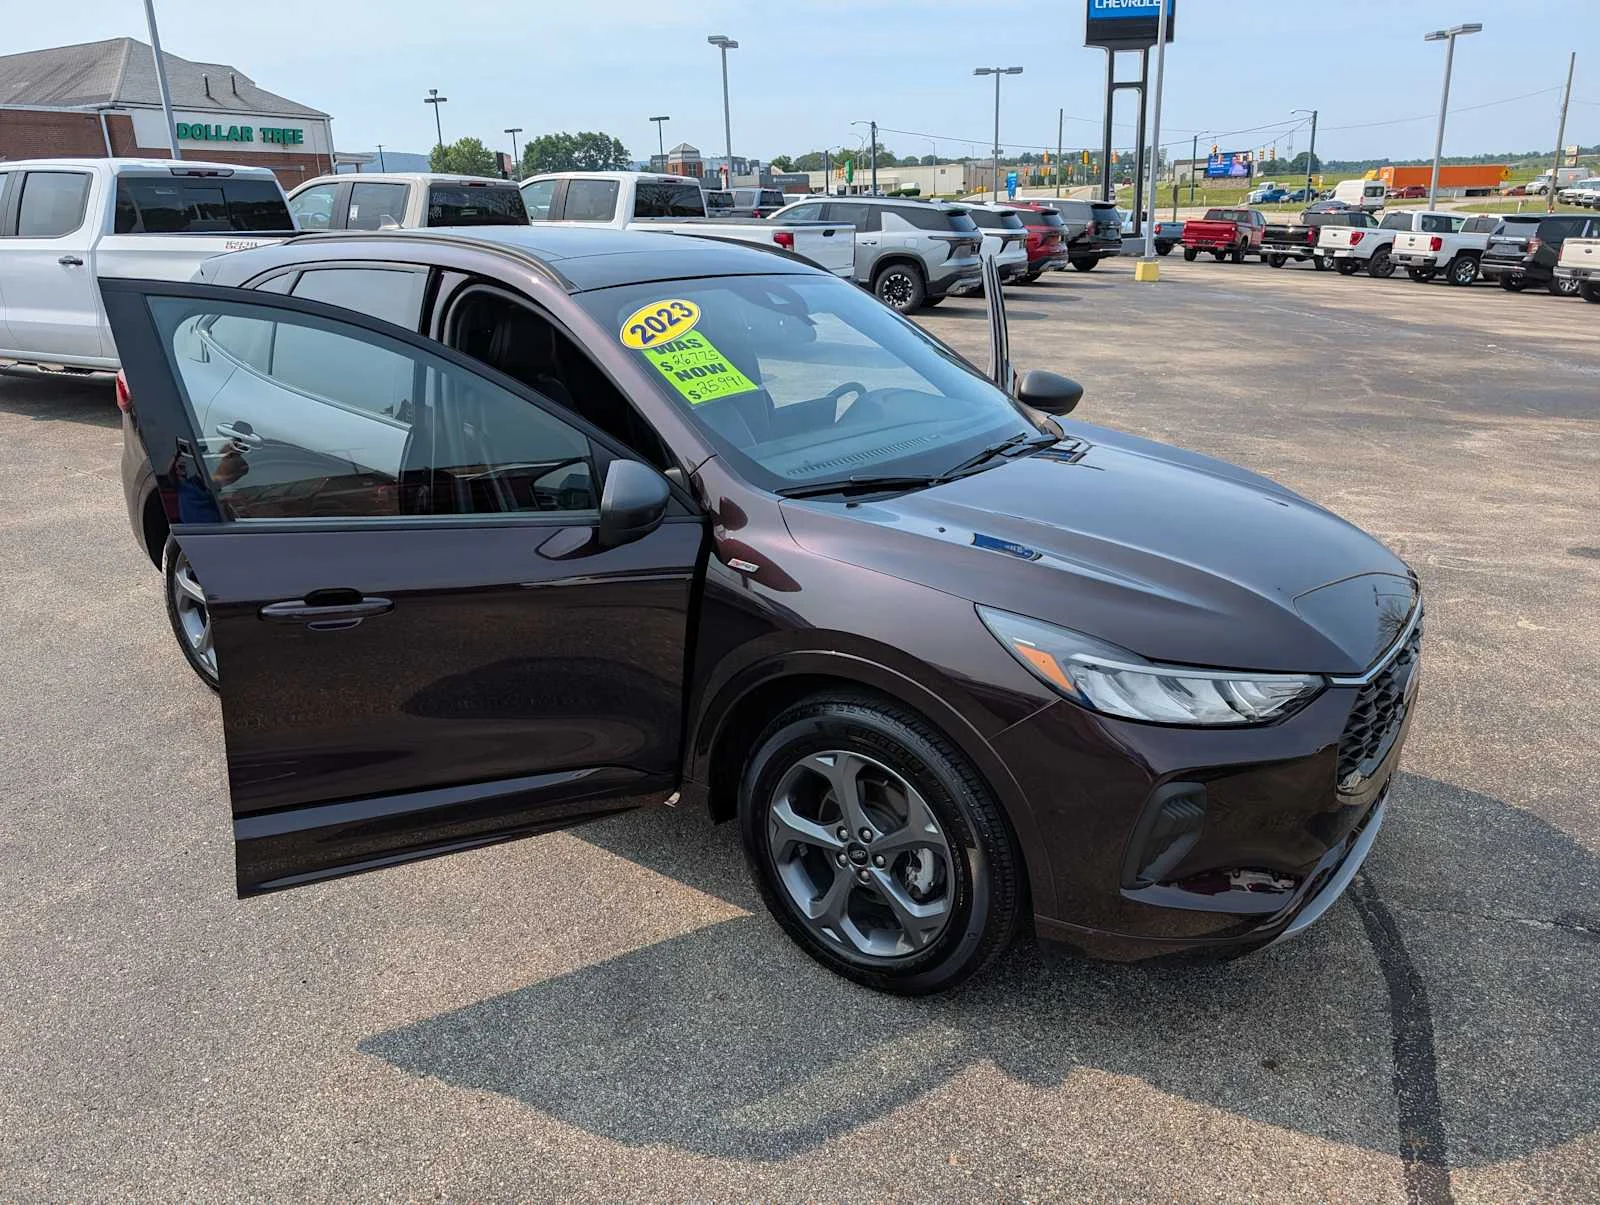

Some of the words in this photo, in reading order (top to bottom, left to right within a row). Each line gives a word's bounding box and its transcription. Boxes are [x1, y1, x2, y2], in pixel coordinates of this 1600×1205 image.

[1095, 0, 1160, 8] CHEVROLE
[176, 122, 254, 142] DOLLAR
[259, 127, 304, 145] TREE
[630, 302, 693, 344] 2023
[651, 338, 703, 355] WAS
[673, 362, 728, 382] NOW
